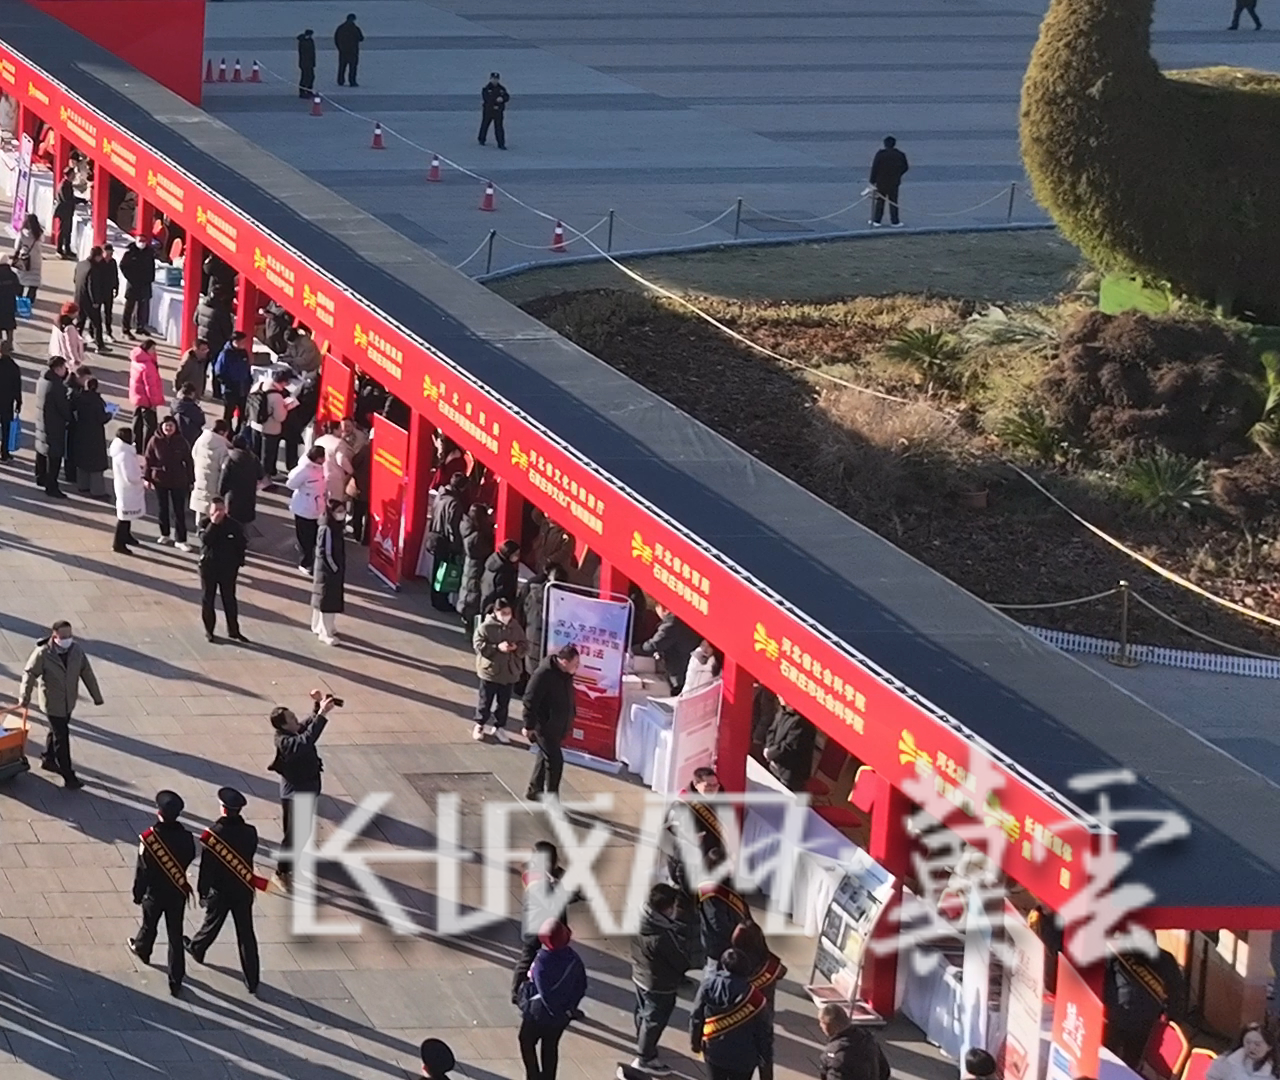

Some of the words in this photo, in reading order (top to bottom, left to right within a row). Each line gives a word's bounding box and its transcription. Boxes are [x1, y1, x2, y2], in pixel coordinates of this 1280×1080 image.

[652, 561, 709, 616] 石家庄市体育局
[654, 542, 711, 596] 河北省体育局
[779, 657, 865, 735] 石家庄市社会科学院
[781, 635, 868, 713] 河北省社会科学院
